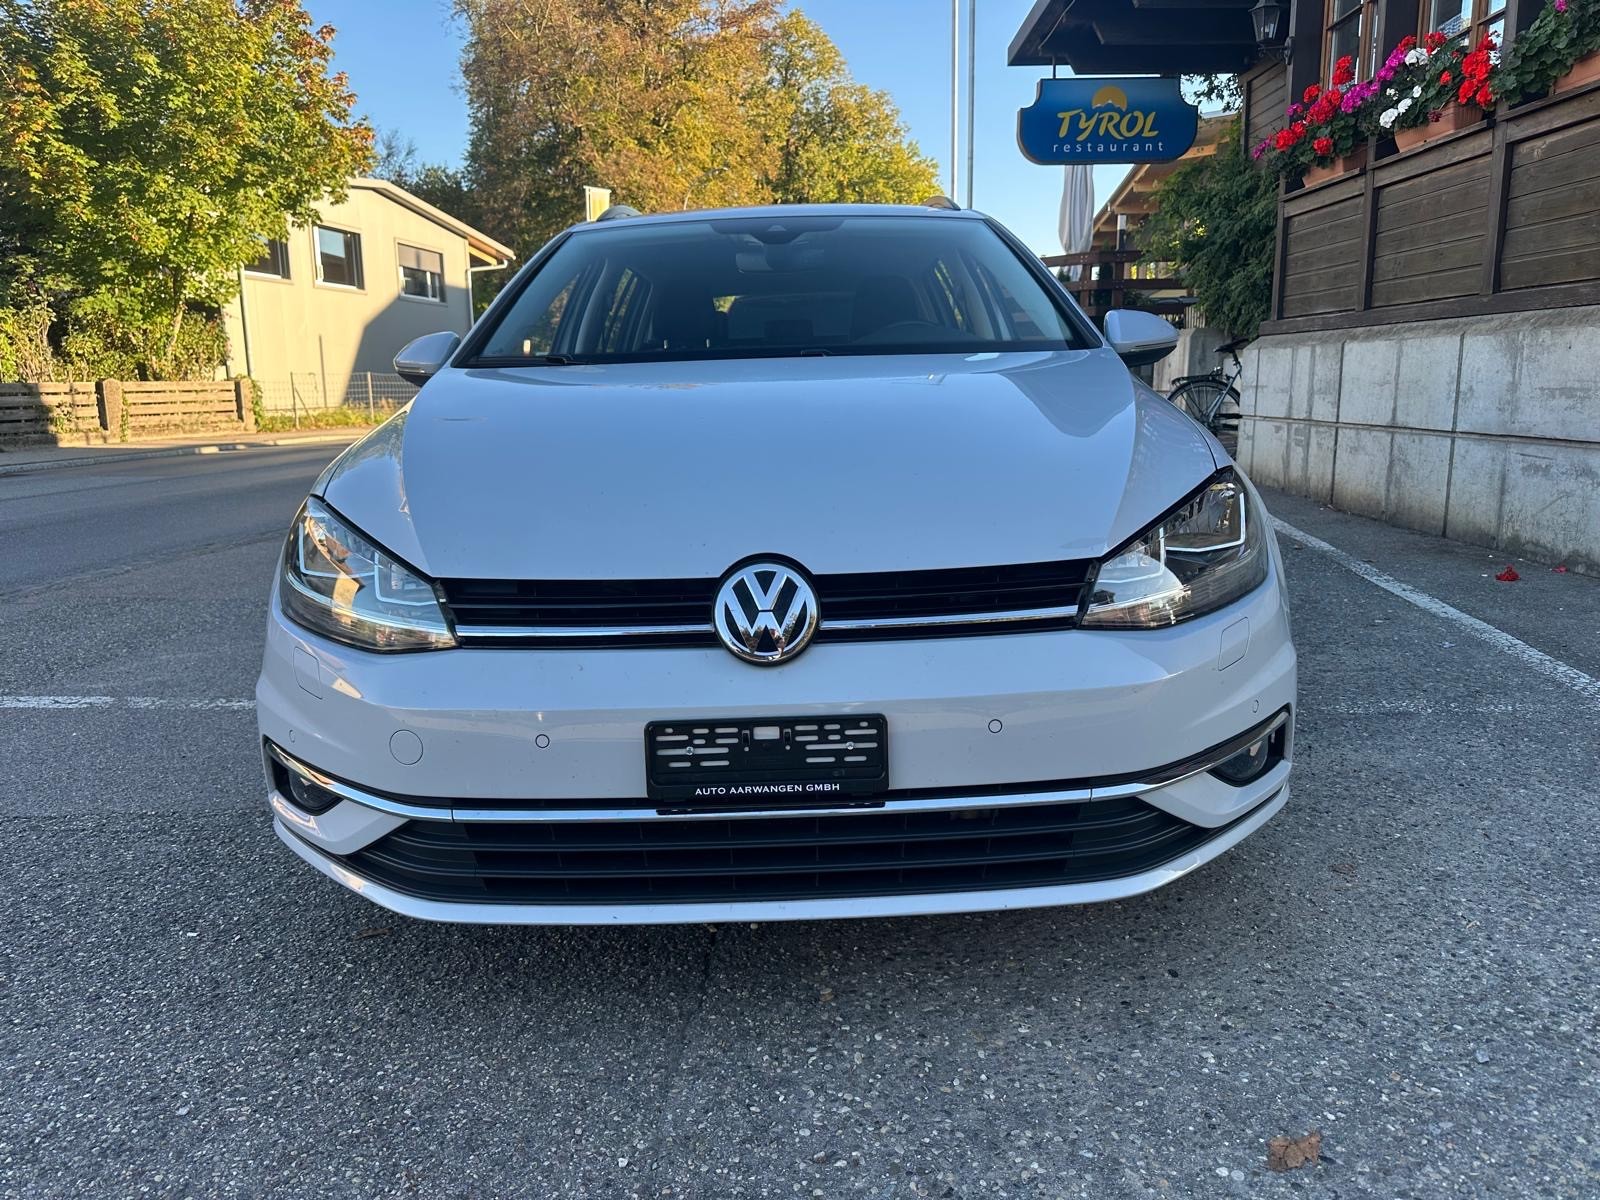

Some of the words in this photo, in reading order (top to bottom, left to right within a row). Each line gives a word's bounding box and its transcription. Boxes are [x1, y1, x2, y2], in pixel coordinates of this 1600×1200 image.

[1057, 109, 1159, 141] TYROL
[1053, 142, 1164, 153] restaurant
[695, 787, 726, 795] AUTO
[729, 784, 802, 794] AARWANGEN
[805, 783, 840, 792] GMBH
